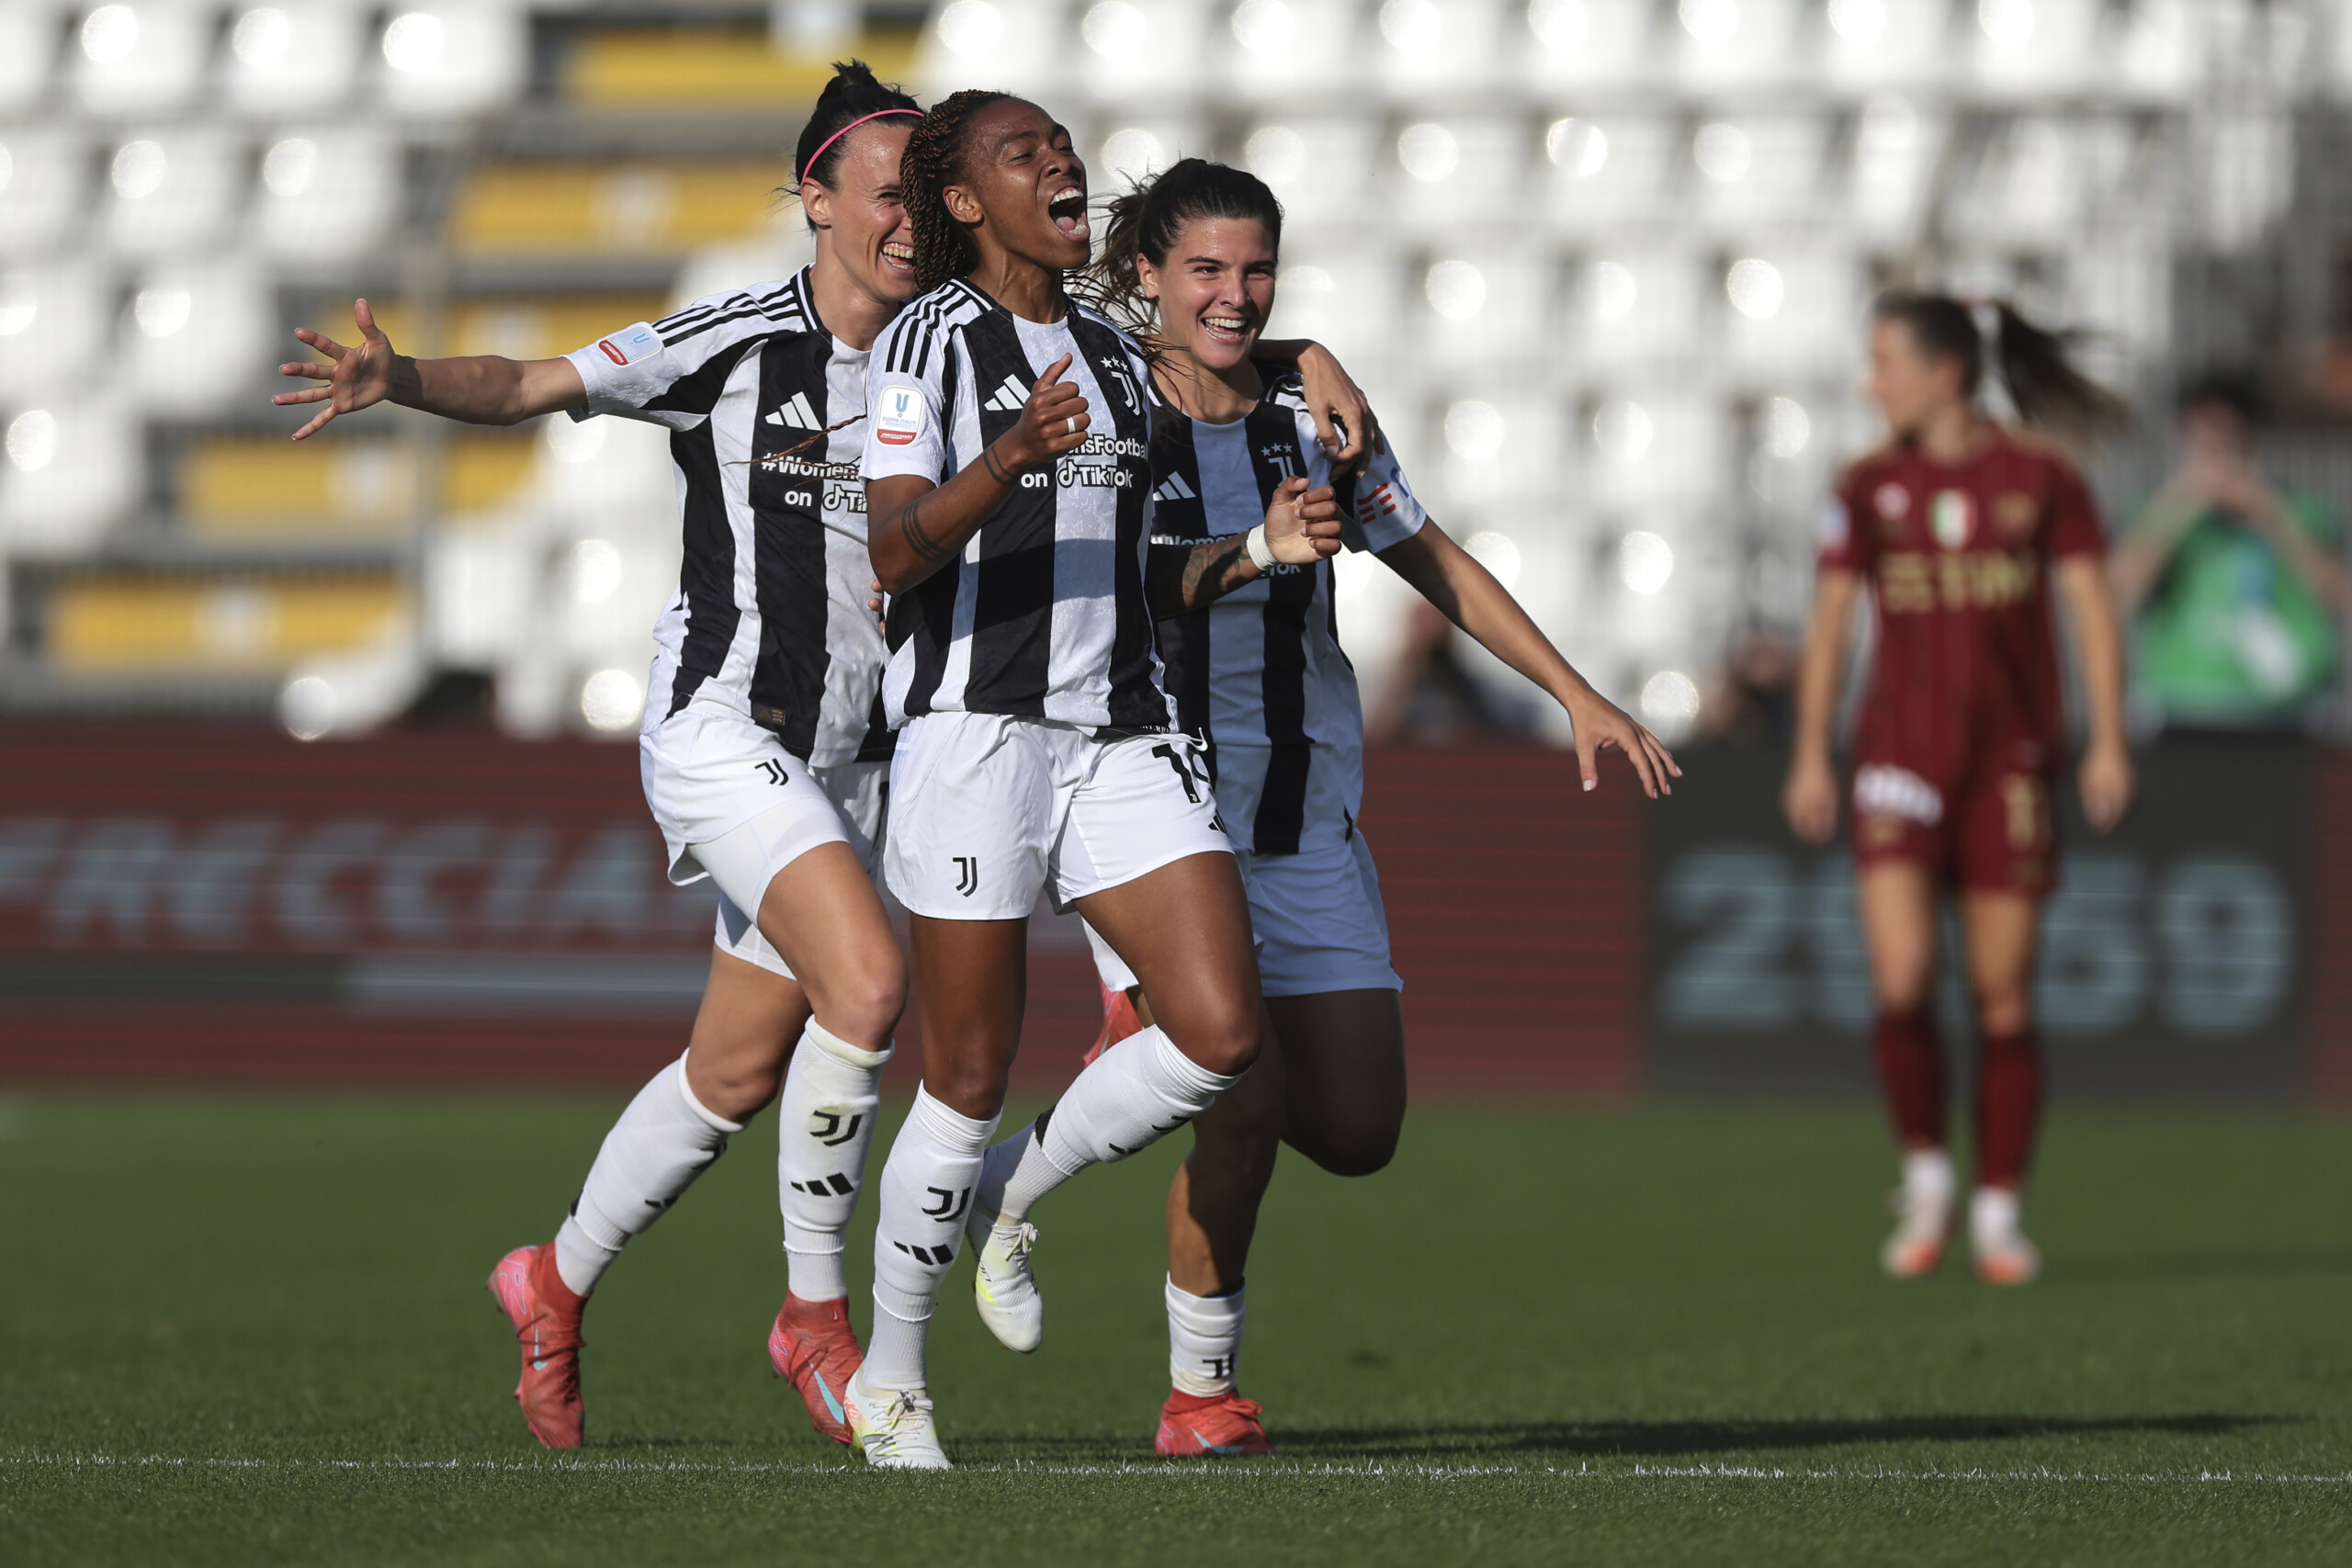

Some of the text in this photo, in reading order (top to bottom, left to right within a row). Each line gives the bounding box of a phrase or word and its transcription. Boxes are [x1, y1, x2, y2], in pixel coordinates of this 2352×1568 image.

[761, 452, 860, 480] #Women
[1020, 465, 1134, 489] on TikTok
[784, 491, 813, 507] on
